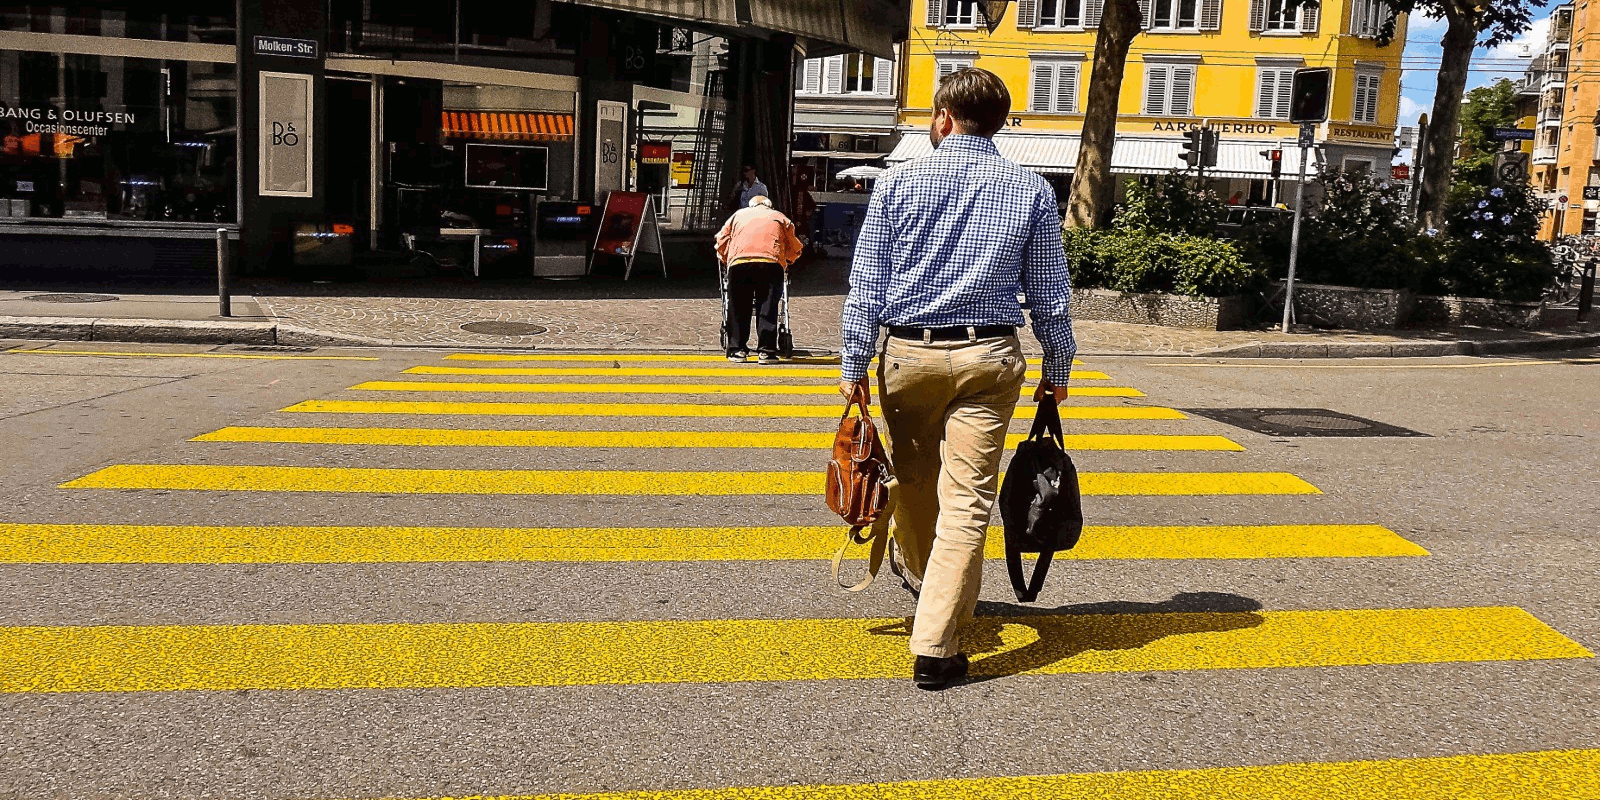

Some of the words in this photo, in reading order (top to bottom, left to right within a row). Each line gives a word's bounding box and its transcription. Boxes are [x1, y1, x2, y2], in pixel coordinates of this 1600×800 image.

[47, 109, 57, 120] &
[62, 110, 135, 124] OLUFSEN
[25, 120, 108, 136] Occasionscenter
[1152, 121, 1277, 134] AARGUERHOF
[1333, 127, 1392, 141] RESTAURANT
